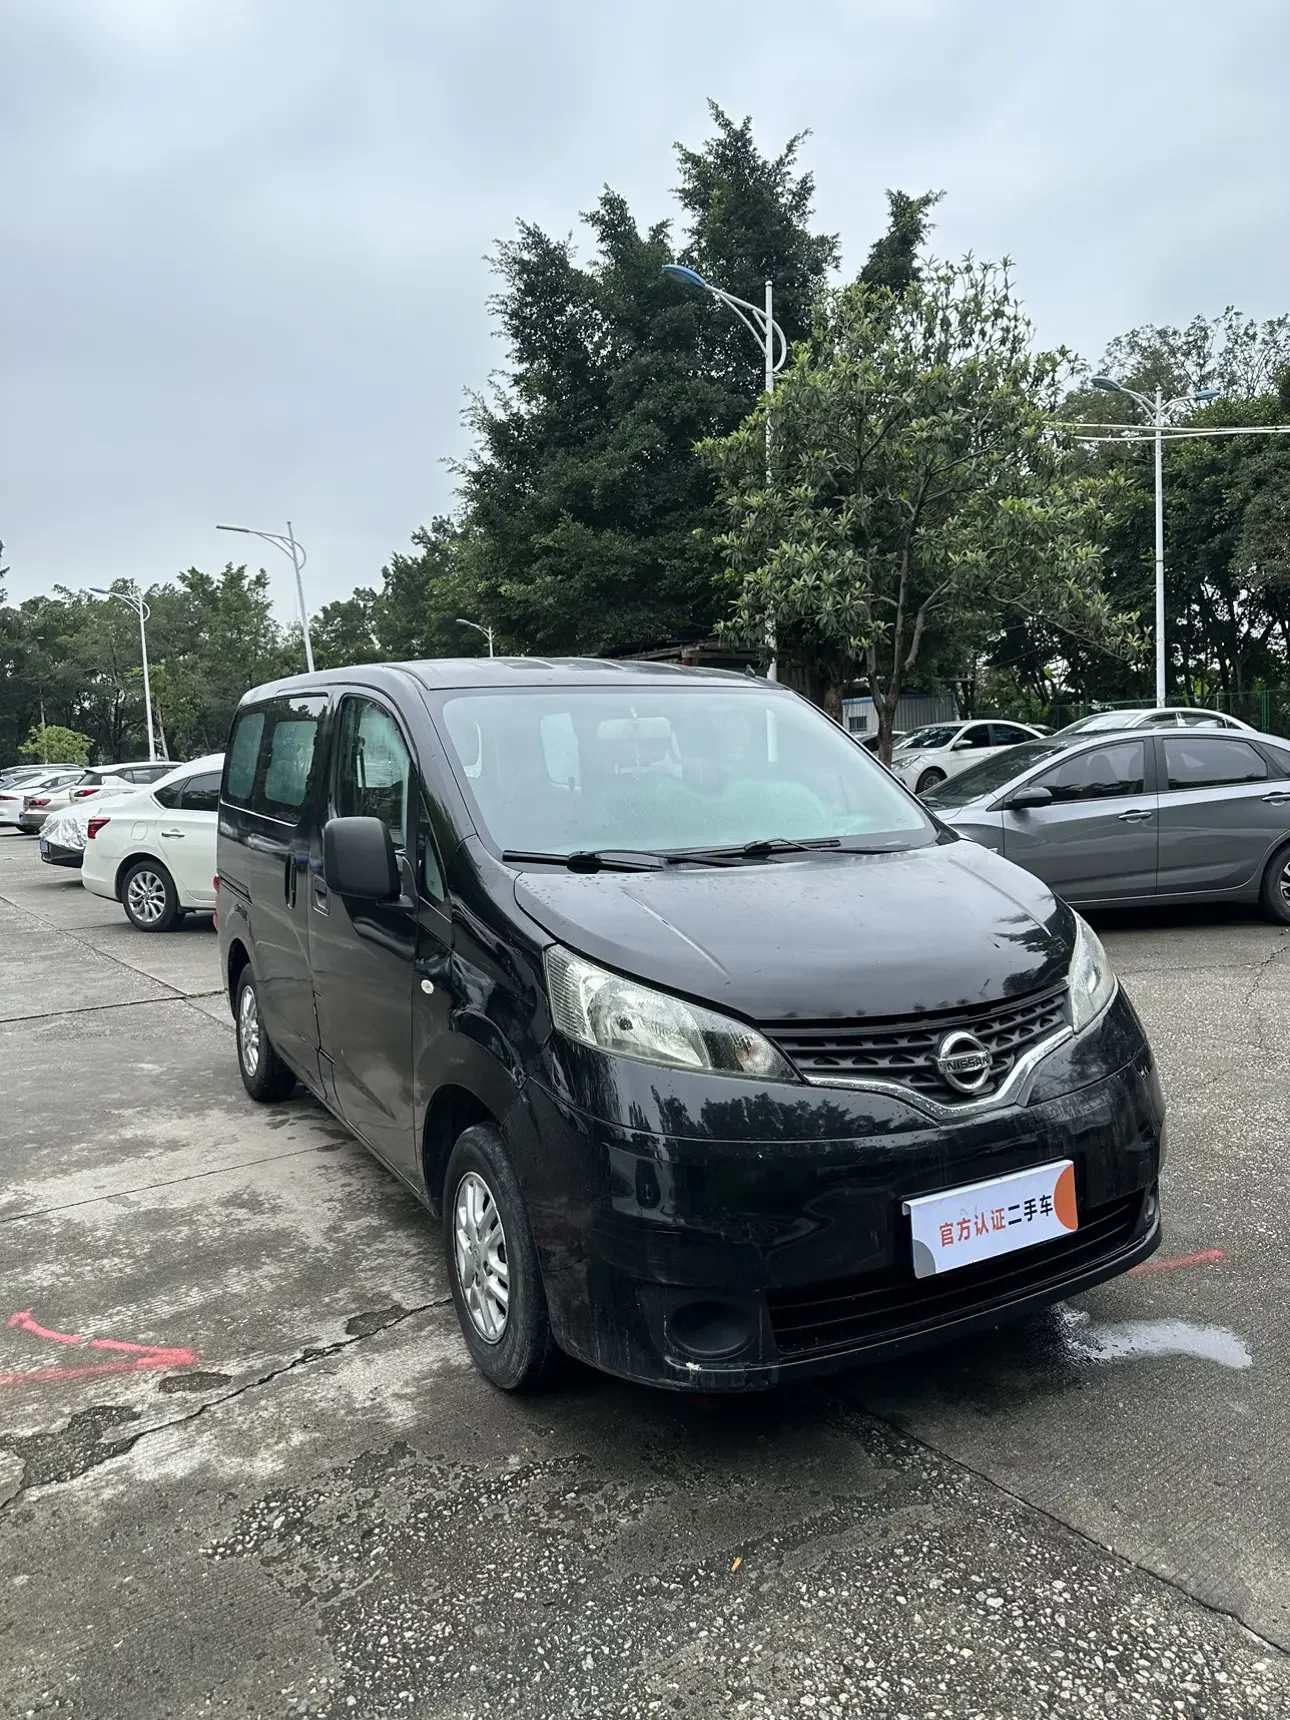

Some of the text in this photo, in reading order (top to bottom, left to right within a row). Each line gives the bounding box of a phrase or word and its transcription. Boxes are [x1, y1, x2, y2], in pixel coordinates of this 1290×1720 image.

[946, 1052, 990, 1071] NISSAN
[939, 1194, 1054, 1248] 官方认证二手车
